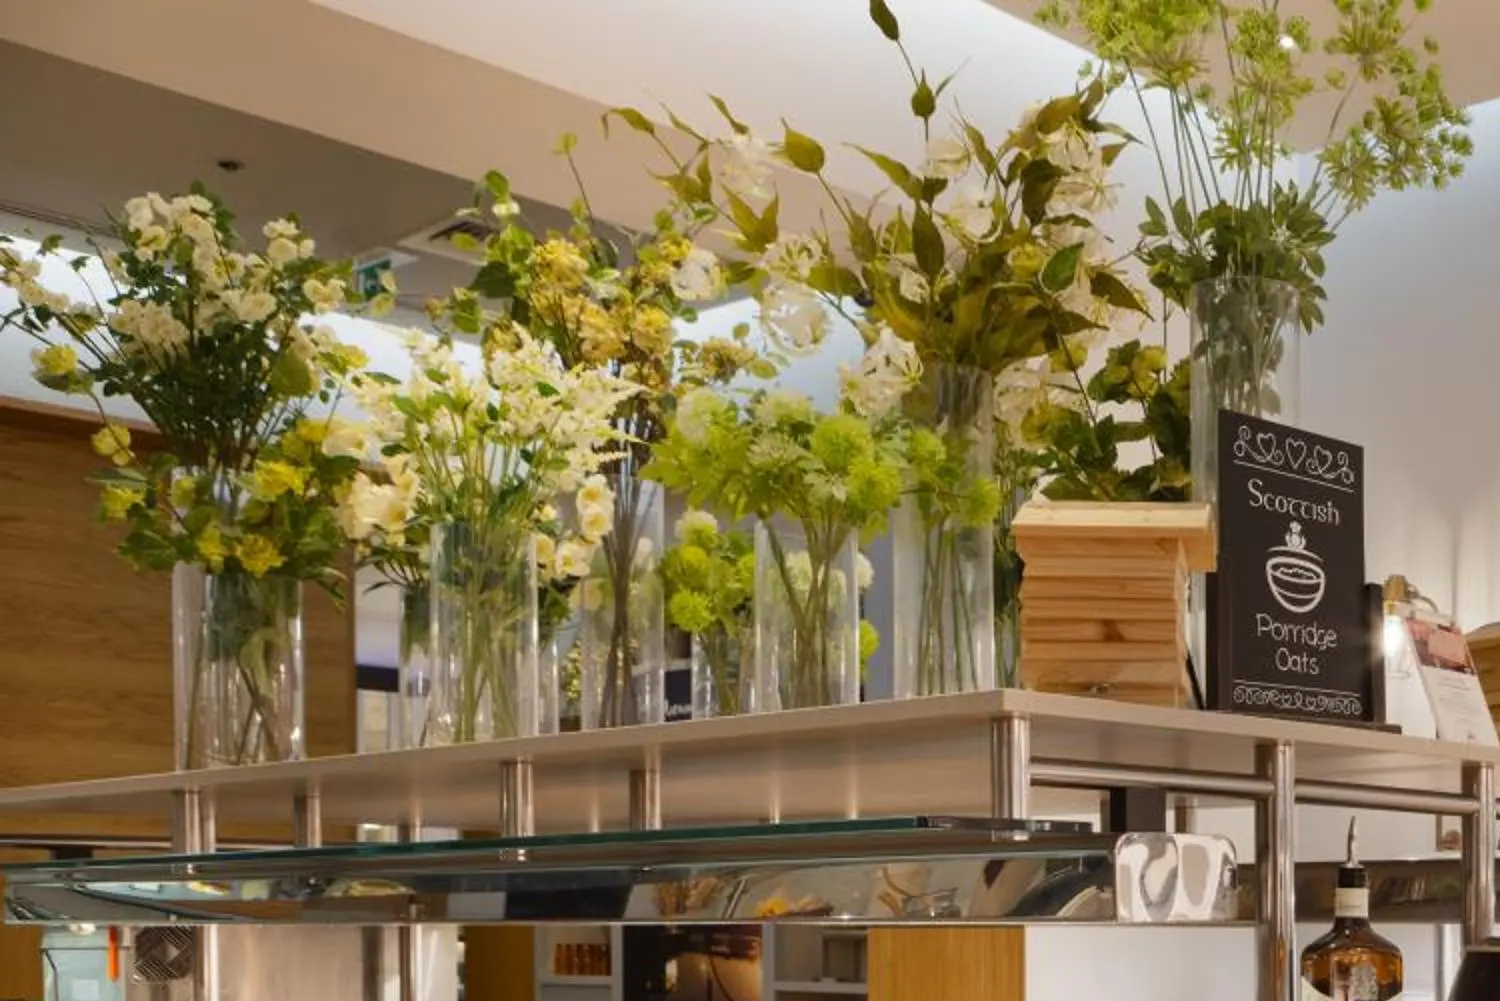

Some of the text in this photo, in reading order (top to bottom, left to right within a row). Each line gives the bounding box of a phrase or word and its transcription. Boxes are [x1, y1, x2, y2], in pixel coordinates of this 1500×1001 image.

[1247, 478, 1340, 525] Scottish
[1256, 613, 1338, 650] Porridge
[1275, 647, 1320, 675] Oats
